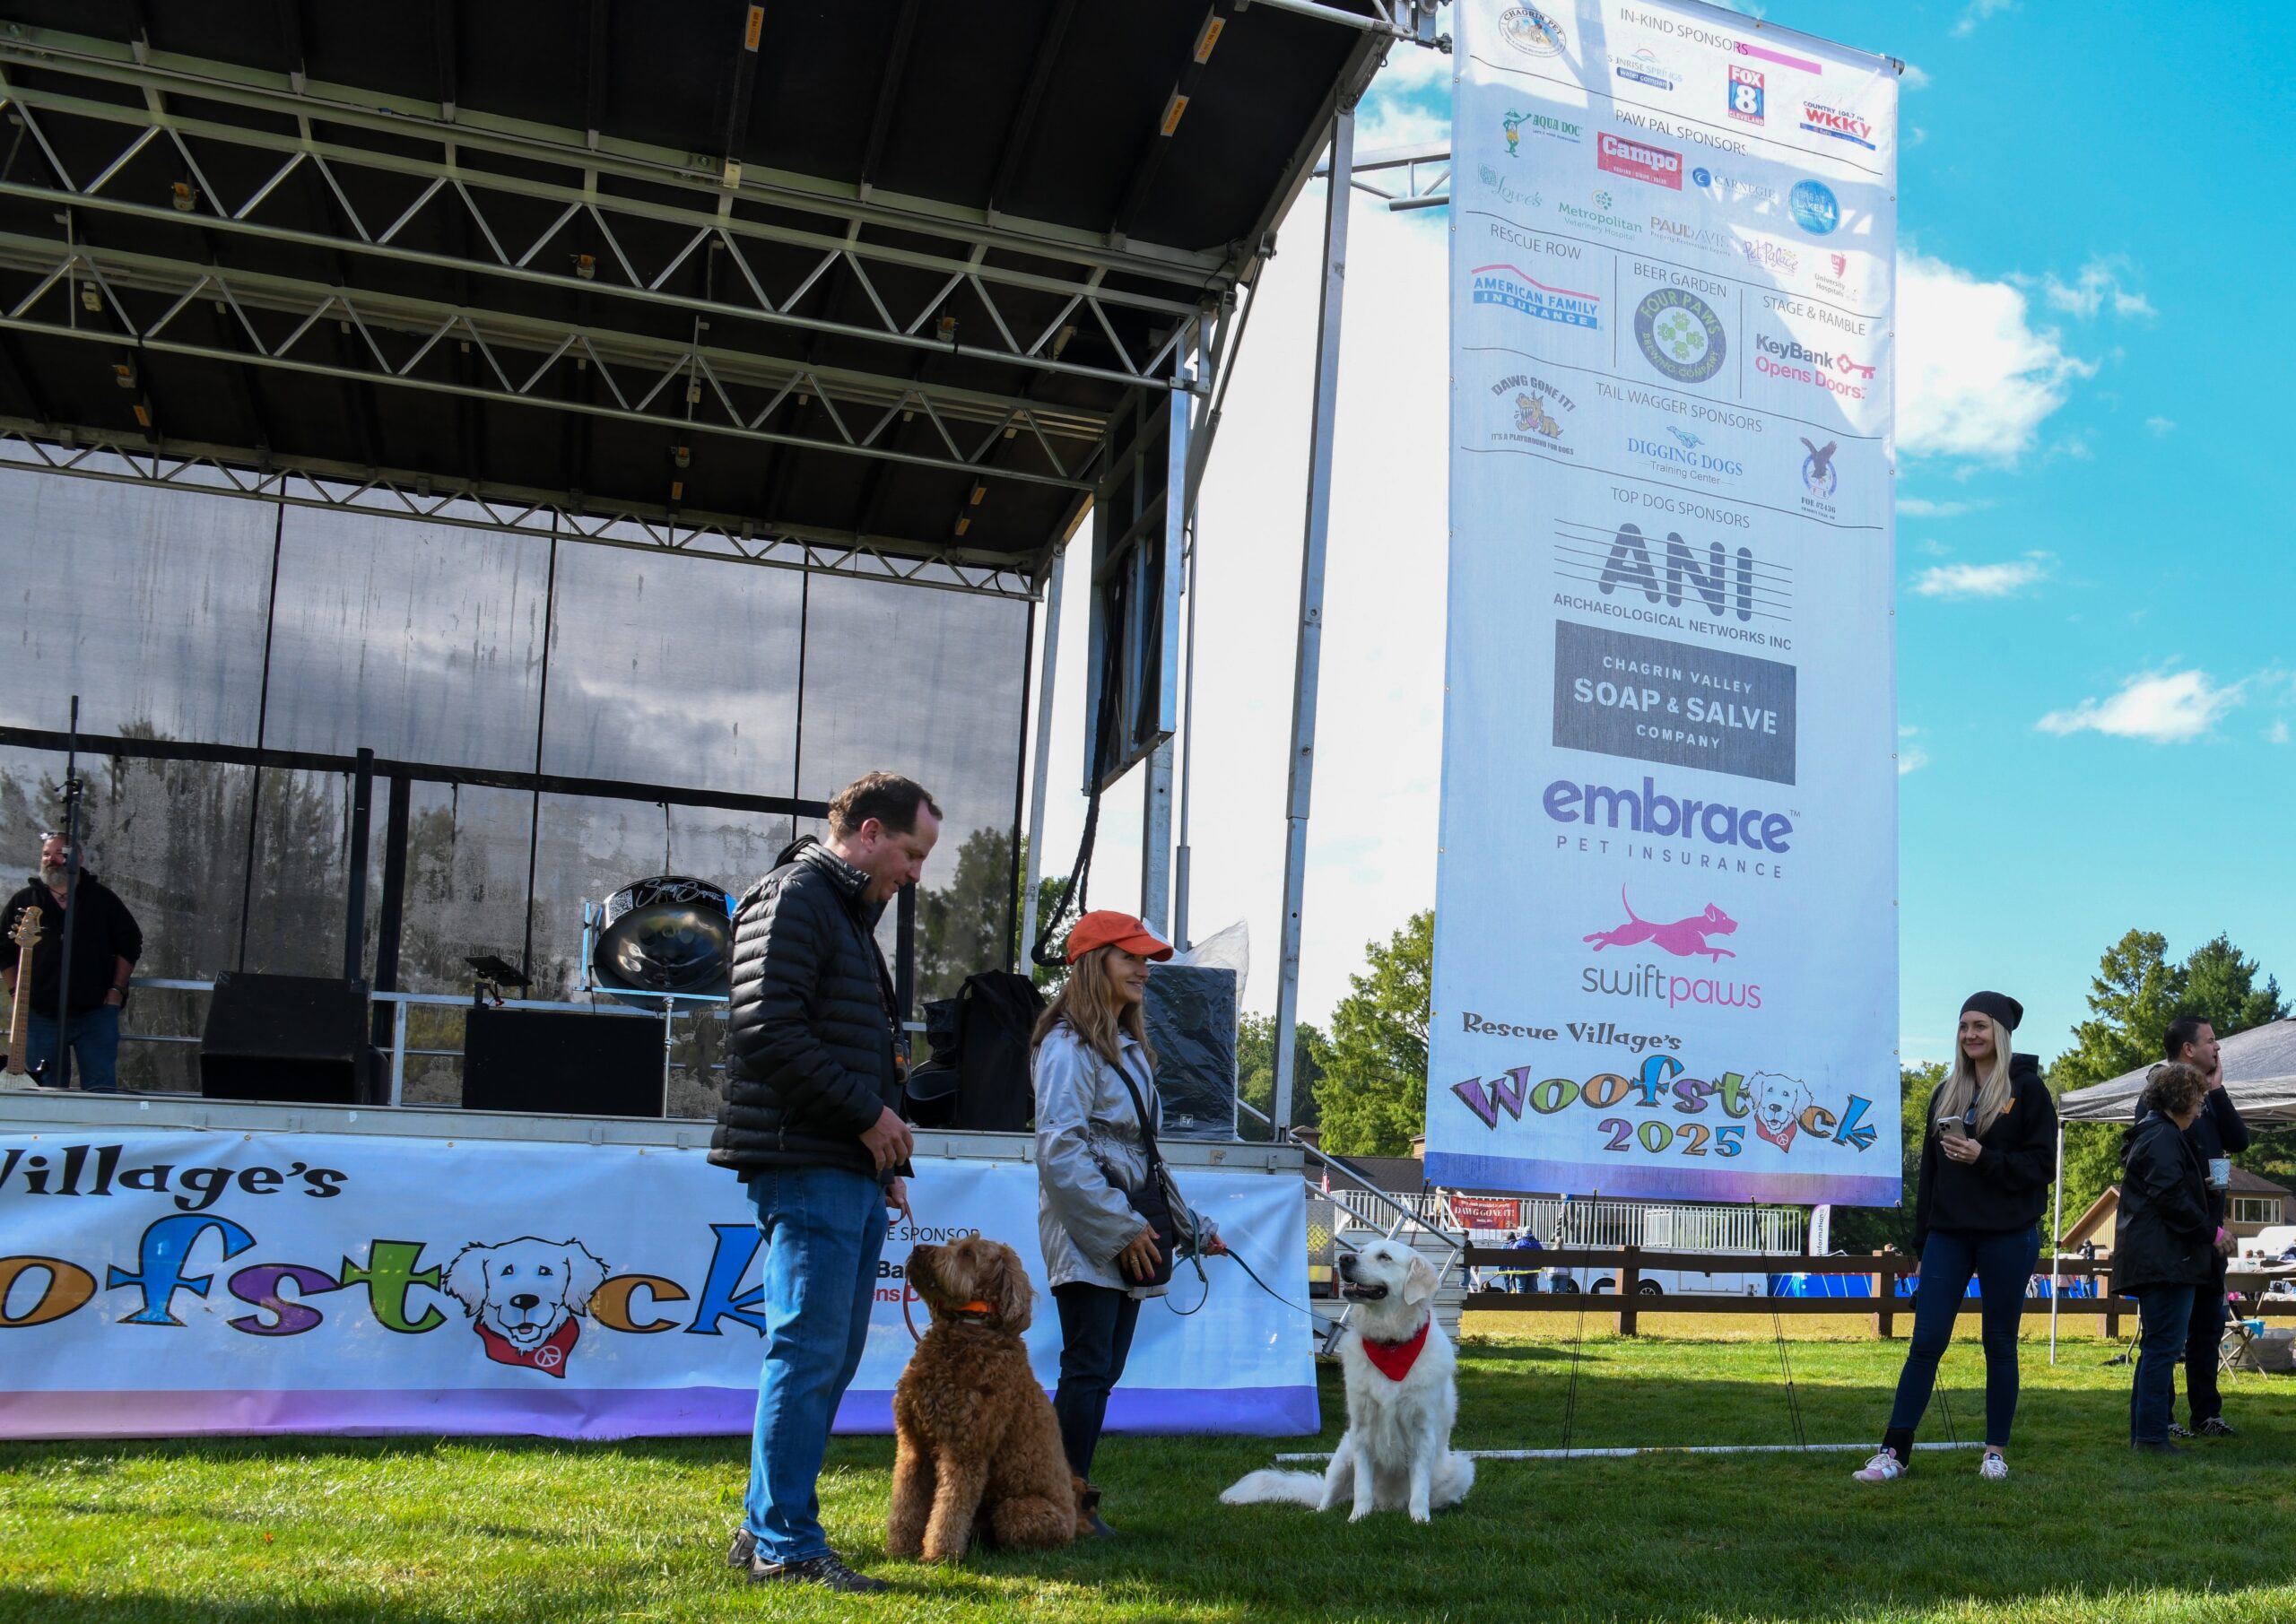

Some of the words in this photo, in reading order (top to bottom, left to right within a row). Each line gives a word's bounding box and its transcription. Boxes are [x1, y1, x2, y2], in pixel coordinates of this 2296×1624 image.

[1503, 9, 1545, 22] CHAGRIN
[1547, 20, 1563, 37] PET
[1621, 7, 1674, 33] IN-KIND
[1676, 24, 1749, 56] SPONSORS
[1732, 66, 1761, 88] FOX
[1735, 84, 1758, 114] 8
[1803, 100, 1836, 115] COUNTRY
[1839, 109, 1856, 119] 104.7
[1532, 114, 1559, 131] AQUA
[1561, 122, 1580, 137] DOC
[1615, 109, 1646, 128] PAW
[1649, 118, 1674, 136] PAL
[1676, 126, 1749, 157] SPONSORS
[1729, 111, 1764, 126] CLEVELAND
[1805, 107, 1873, 139] WKKY
[1603, 136, 1678, 172] Campo
[1557, 201, 1643, 234] Metropolitan
[1796, 199, 1825, 214] LAKES
[1491, 223, 1542, 253] RESCUE
[1545, 241, 1582, 260] ROW
[1564, 217, 1603, 234] Veterinary
[1605, 226, 1635, 242] Hospital
[1650, 216, 1690, 239] PAUL
[1743, 239, 1762, 263] Pet
[1762, 241, 1799, 270] Palace
[1474, 277, 1543, 304] AMERICAN
[1548, 294, 1599, 316] FAMILY
[1633, 262, 1667, 282] BEER
[1670, 272, 1727, 298] GARDEN
[1814, 273, 1846, 291] University
[1815, 282, 1844, 298] Hospitals
[1483, 292, 1588, 325] INSURANCE
[1639, 291, 1678, 319] FOUR
[1682, 292, 1722, 335] PAWS
[1762, 295, 1804, 317] STAGE
[1806, 306, 1816, 319] &
[1819, 309, 1866, 336] RAMBLE
[1642, 329, 1676, 374] BREWING
[1678, 350, 1718, 378] COMPANY
[1755, 333, 1834, 369] KeyBank
[1755, 355, 1812, 383] Opens
[1491, 374, 1529, 396] DAWG
[1530, 377, 1560, 400] GONE
[1558, 394, 1577, 413] IT!
[1595, 381, 1625, 401] TAIL
[1627, 389, 1687, 415] WAGGER
[1690, 404, 1763, 433] SPONSORS
[1509, 433, 1547, 448] PLAYGROUND
[1547, 442, 1558, 451] FOR
[1558, 445, 1575, 456] DOGS
[1627, 437, 1698, 466] DIGGING
[1700, 454, 1744, 477] DOGS
[1649, 460, 1687, 480] Training
[1690, 469, 1721, 486] Center
[1610, 486, 1639, 504] TOP
[1643, 493, 1674, 512] DOG
[1678, 501, 1751, 529] SPONSORS
[1597, 522, 1752, 622] ANI
[1553, 593, 1684, 630] ARCHAEOLOGICAL
[1688, 620, 1766, 646] NETWORKS
[1769, 635, 1793, 651] INC
[1603, 656, 1683, 682] CHAGRIN
[1689, 671, 1753, 695] VALLEY
[1573, 677, 1661, 713] SOAP
[1666, 696, 1680, 715] &
[1686, 696, 1778, 735] SALVE
[1635, 724, 1721, 750] COMPANY
[1542, 776, 1794, 854] embrace
[1556, 835, 1610, 855] PET
[1628, 845, 1782, 879] INSURANCE
[1461, 1011, 1559, 1041] Rescue
[1566, 1022, 1683, 1054] Village's
[1449, 1054, 1878, 1154] Woofstck
[1597, 1117, 1746, 1158] 2025
[1455, 1206, 1479, 1216] DAWG
[1480, 1208, 1502, 1217] GONE
